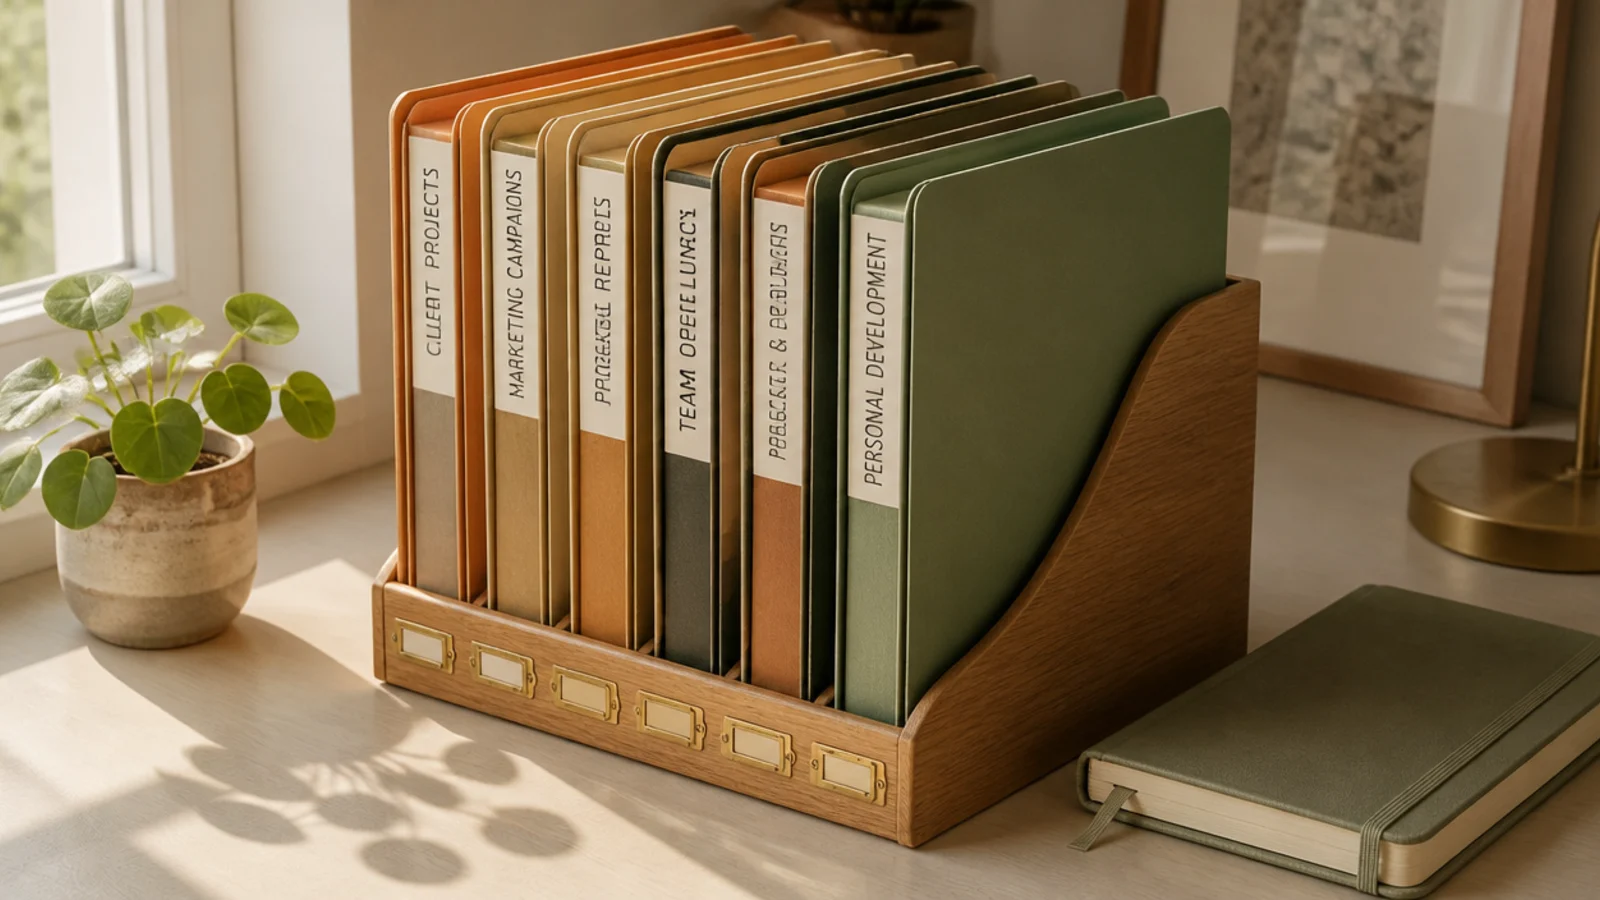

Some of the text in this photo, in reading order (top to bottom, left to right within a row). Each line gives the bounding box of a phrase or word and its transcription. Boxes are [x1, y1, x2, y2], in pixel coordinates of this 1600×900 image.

[422, 167, 439, 270] PROJECTS
[768, 338, 787, 353] &
[865, 232, 887, 487] PERSONAL DEVELOPMENT
[679, 368, 697, 432] TEAM
